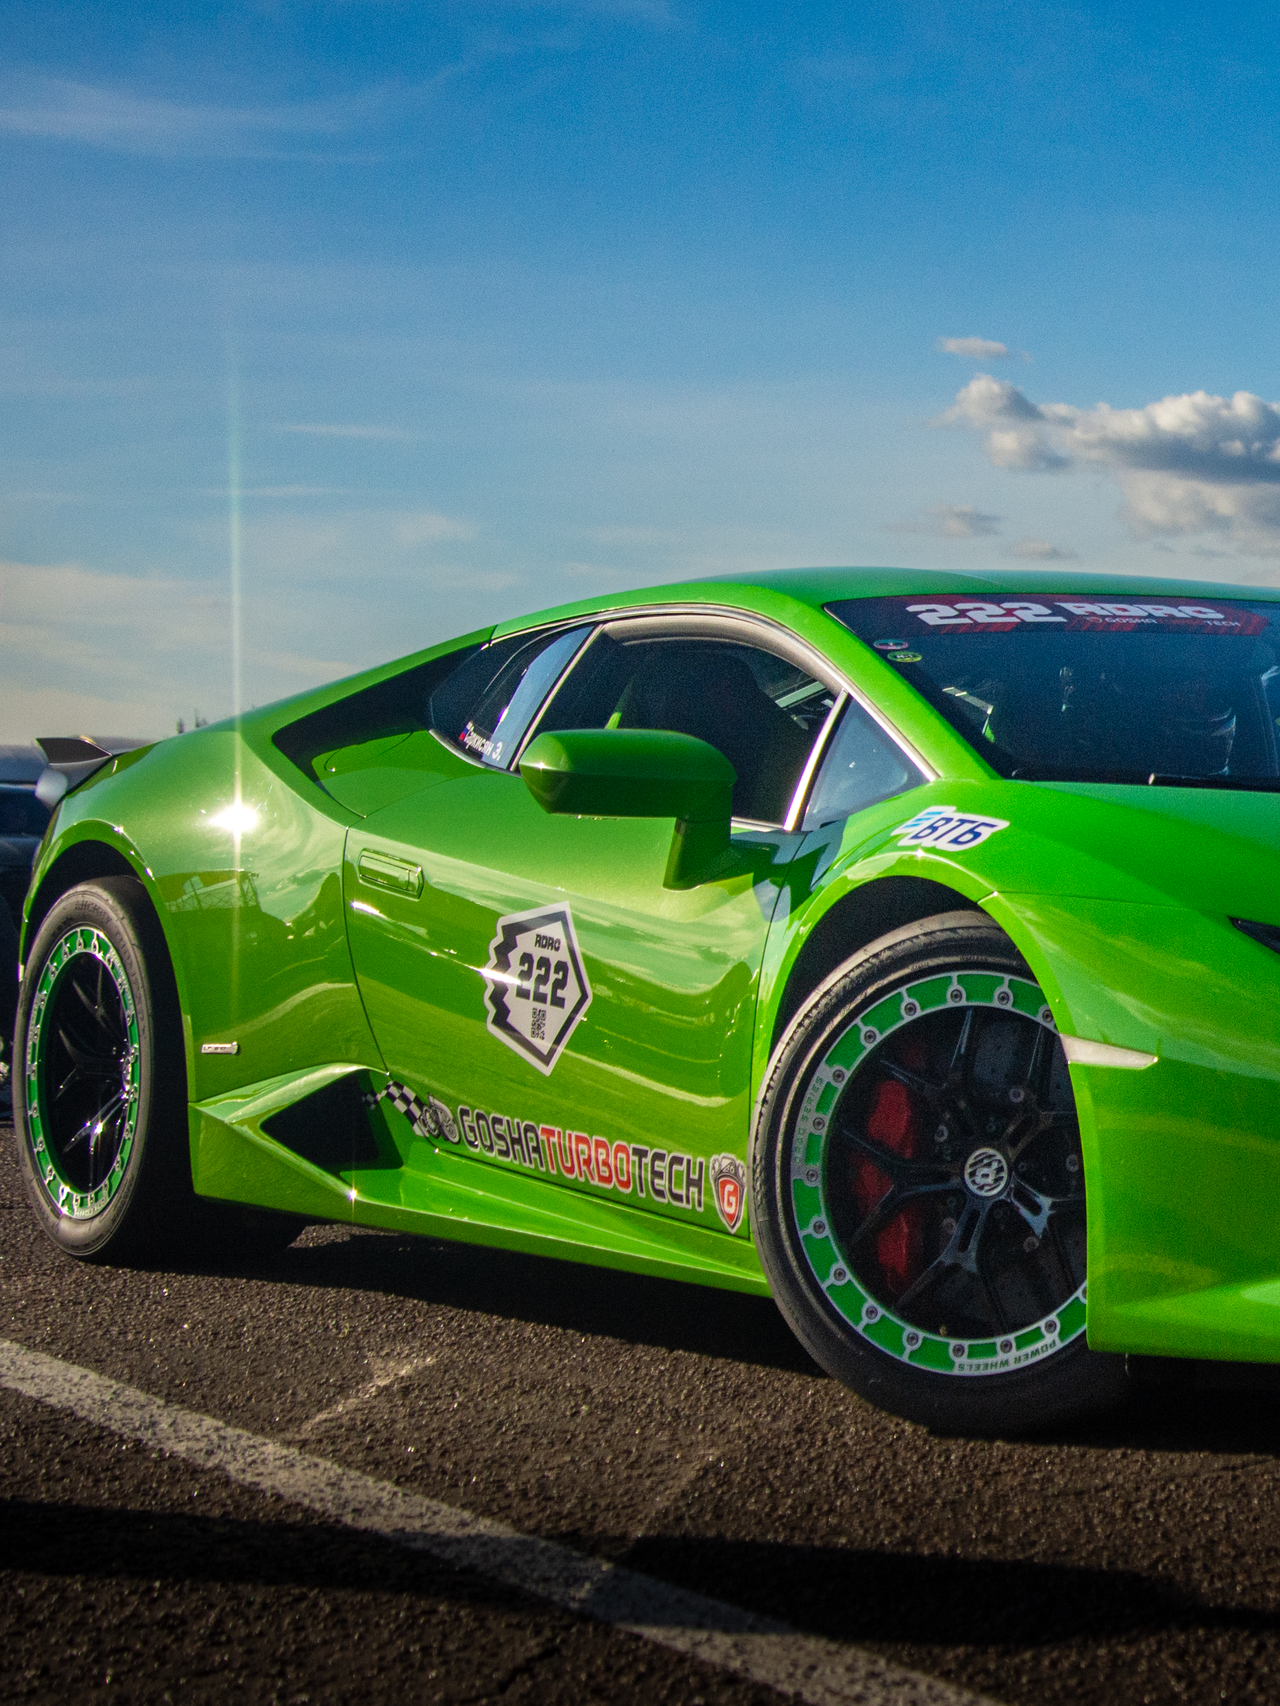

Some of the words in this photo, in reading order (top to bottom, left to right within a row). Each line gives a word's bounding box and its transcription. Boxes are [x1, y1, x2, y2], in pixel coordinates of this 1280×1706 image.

[906, 602, 1068, 626] 222
[1054, 602, 1225, 619] RDRC
[908, 817, 999, 845] ВТБ
[534, 933, 561, 952] RDRC
[515, 952, 569, 1010] 222
[801, 1075, 823, 1120] SERIES
[1014, 1339, 1057, 1364] POWER
[958, 1357, 1010, 1372] WHEELS
